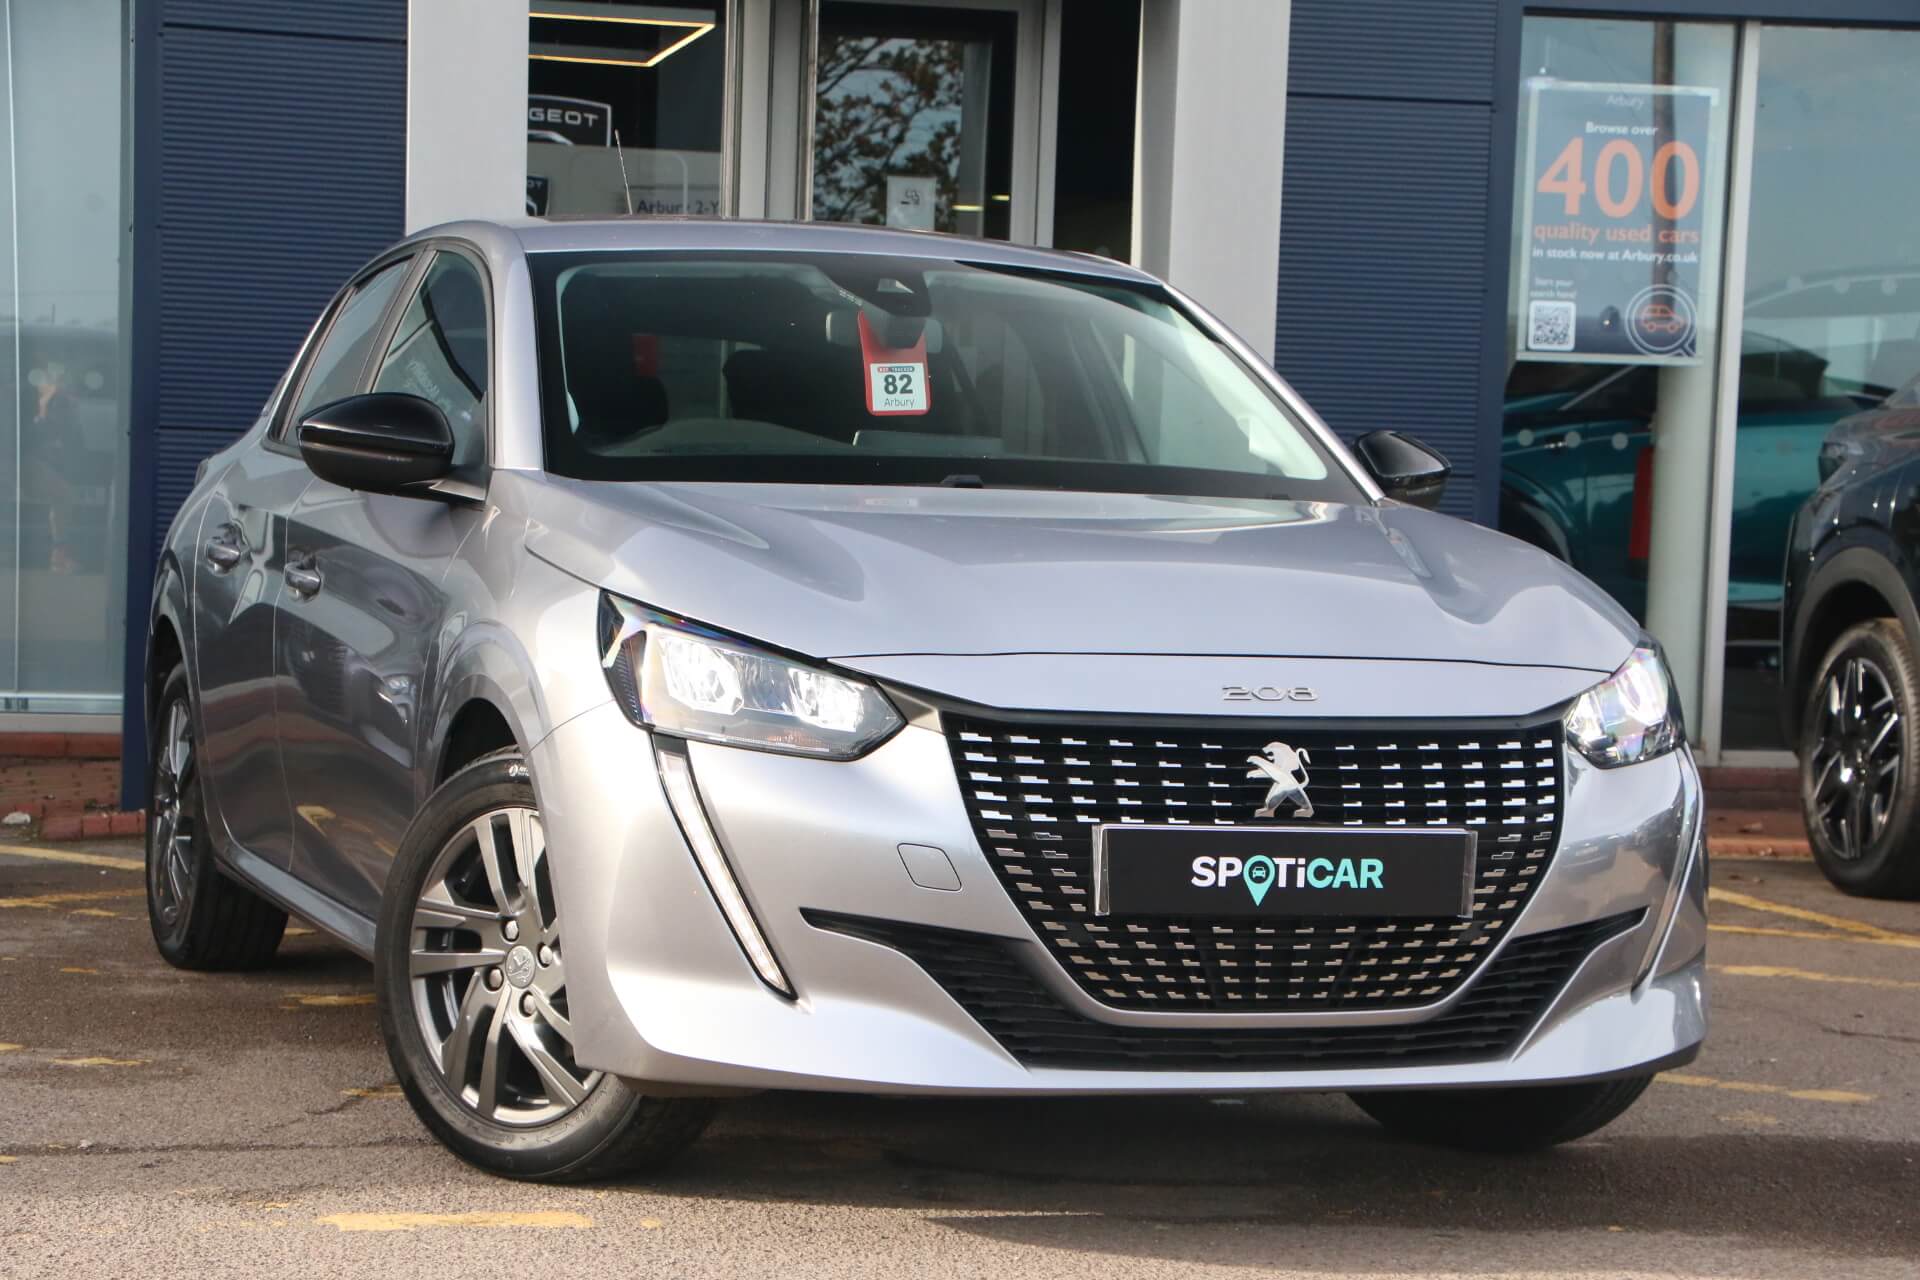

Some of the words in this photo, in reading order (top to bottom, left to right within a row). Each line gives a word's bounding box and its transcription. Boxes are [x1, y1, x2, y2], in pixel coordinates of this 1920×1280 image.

[1585, 121, 1628, 135] Browse
[1631, 126, 1658, 136] over
[1536, 137, 1700, 219] 400
[1535, 222, 1599, 246] quality
[1606, 224, 1652, 242] used
[1658, 230, 1699, 243] cars
[1532, 247, 1544, 258] in
[1547, 248, 1577, 260] stock
[1580, 251, 1605, 261] now
[1608, 251, 1620, 261] at
[1622, 250, 1698, 264] Arbury.co.uk
[884, 374, 914, 394] 82
[884, 398, 915, 408] Arbury
[1222, 686, 1320, 702] 208
